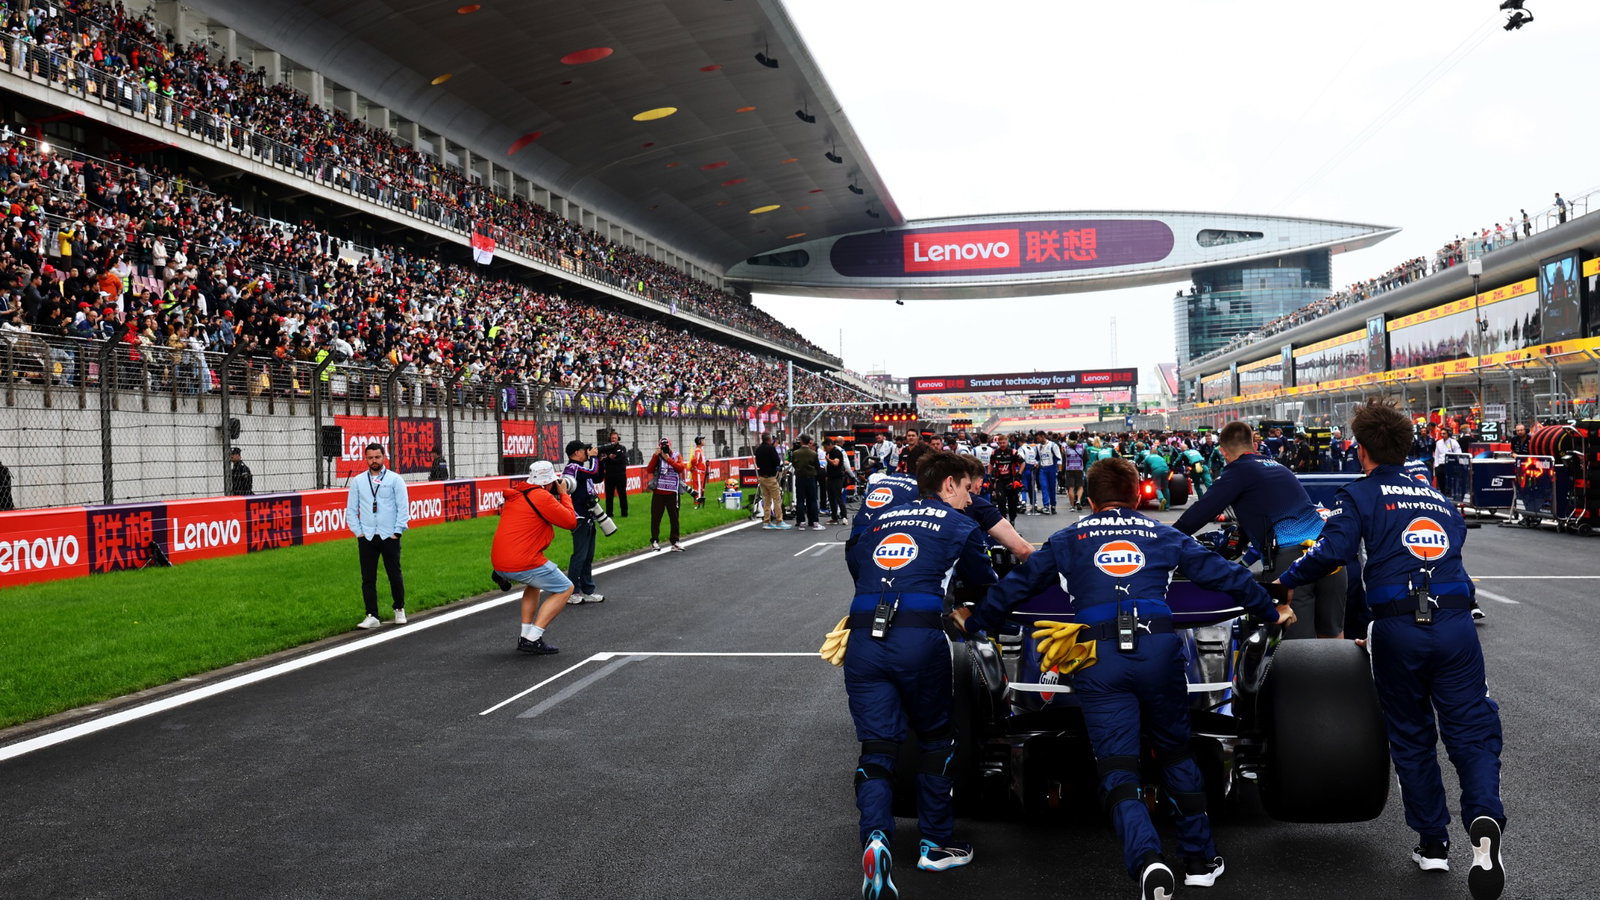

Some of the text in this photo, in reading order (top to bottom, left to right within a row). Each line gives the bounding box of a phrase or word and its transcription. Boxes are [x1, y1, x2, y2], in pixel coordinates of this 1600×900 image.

[914, 241, 1010, 262] Lenovo
[1025, 228, 1098, 263] 联想
[970, 379, 1003, 388] Smarter
[1005, 376, 1051, 386] technology
[1052, 375, 1065, 383] for
[1066, 374, 1076, 383] all
[1482, 422, 1498, 432] 22
[502, 430, 535, 456] Lenovo
[626, 476, 641, 491] enovo
[446, 484, 471, 521] 联想
[868, 493, 891, 502] Gulf
[408, 498, 442, 521] enovo
[878, 507, 948, 520] KOMATSU
[1398, 501, 1451, 517] MYPROTEIN
[249, 500, 293, 551] 联想
[305, 505, 348, 534] Lenov
[881, 519, 941, 532] MYPROTEIN
[1077, 516, 1155, 529] KOMATSU
[92, 511, 153, 572] 联想
[173, 517, 241, 551] Lenovo
[1089, 529, 1158, 539] MYPROTEIN
[1405, 533, 1446, 546] Gulf
[0, 534, 79, 573] enovo
[875, 545, 916, 558] Gulf
[1097, 553, 1143, 564] Gulf
[1040, 672, 1057, 685] Gulf
